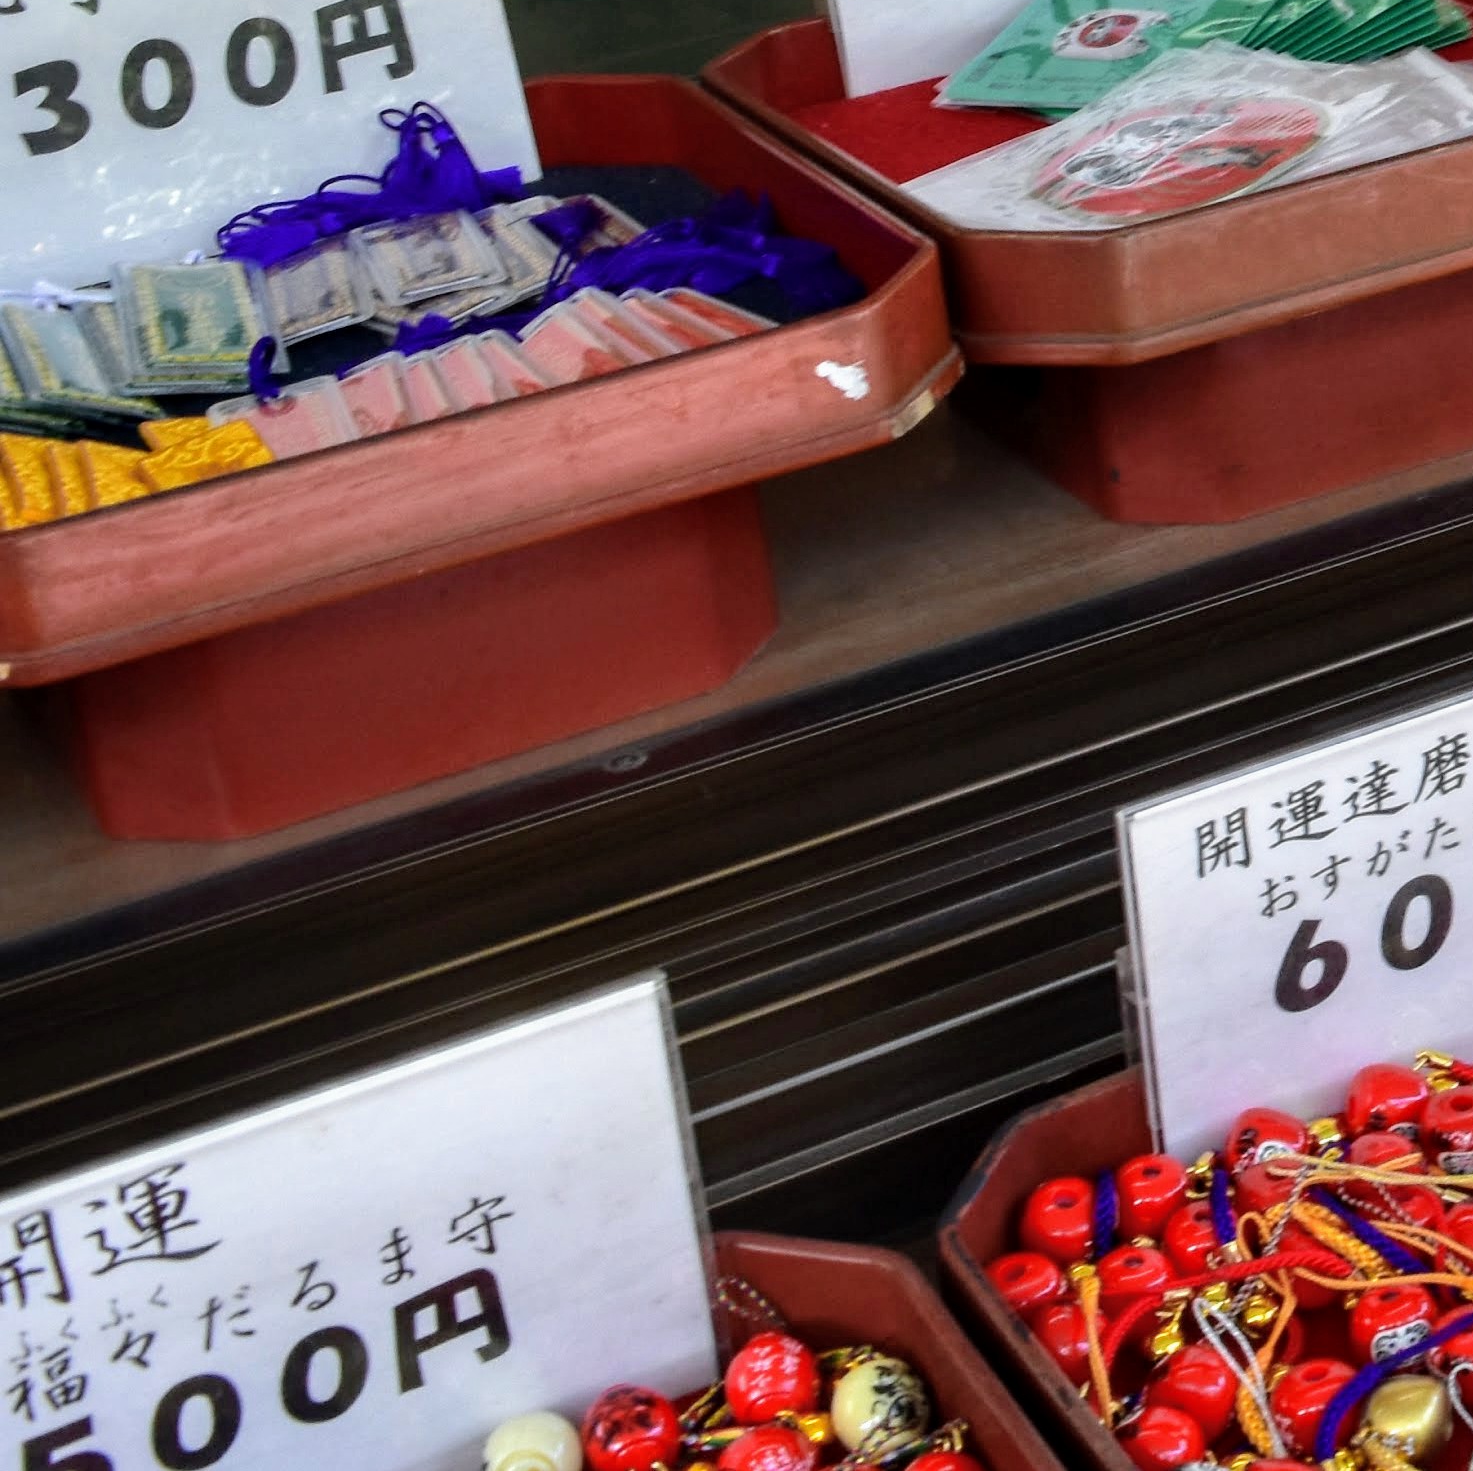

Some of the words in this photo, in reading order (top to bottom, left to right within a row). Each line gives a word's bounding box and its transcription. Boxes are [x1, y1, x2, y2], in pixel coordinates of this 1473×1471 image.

[0, 1161, 224, 1309] 開運
[5, 1193, 518, 1426] 福々だるま守
[18, 1265, 515, 1471] 500円
